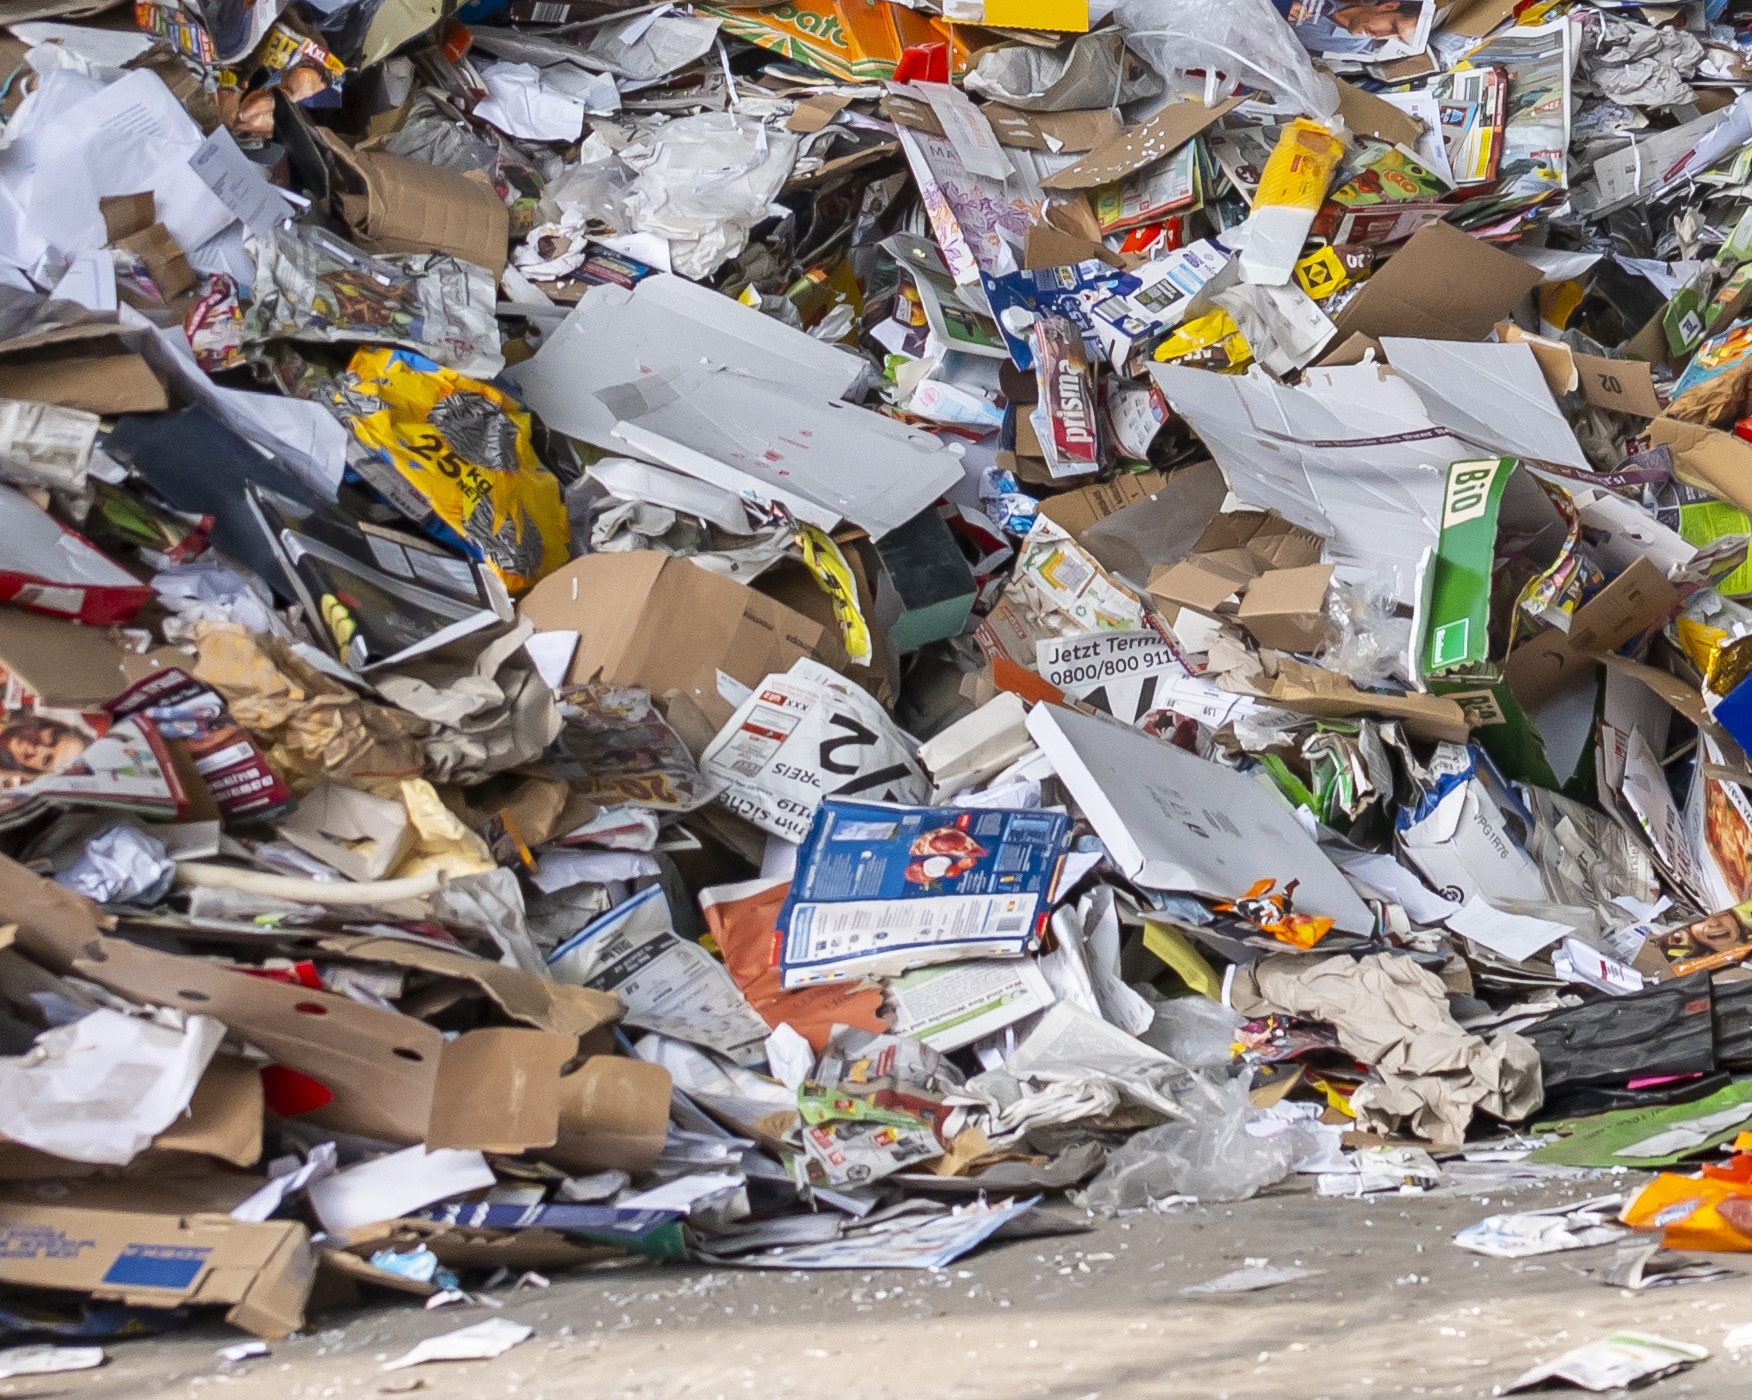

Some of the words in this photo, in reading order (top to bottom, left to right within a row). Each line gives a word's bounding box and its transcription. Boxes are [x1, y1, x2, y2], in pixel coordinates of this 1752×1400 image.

[304, 40, 327, 62] XXL
[1056, 358, 1095, 446] prisma
[408, 433, 469, 479] 25
[467, 468, 494, 494] kg
[1049, 640, 1101, 665] Jetzt
[1051, 654, 1139, 687] 0800/800
